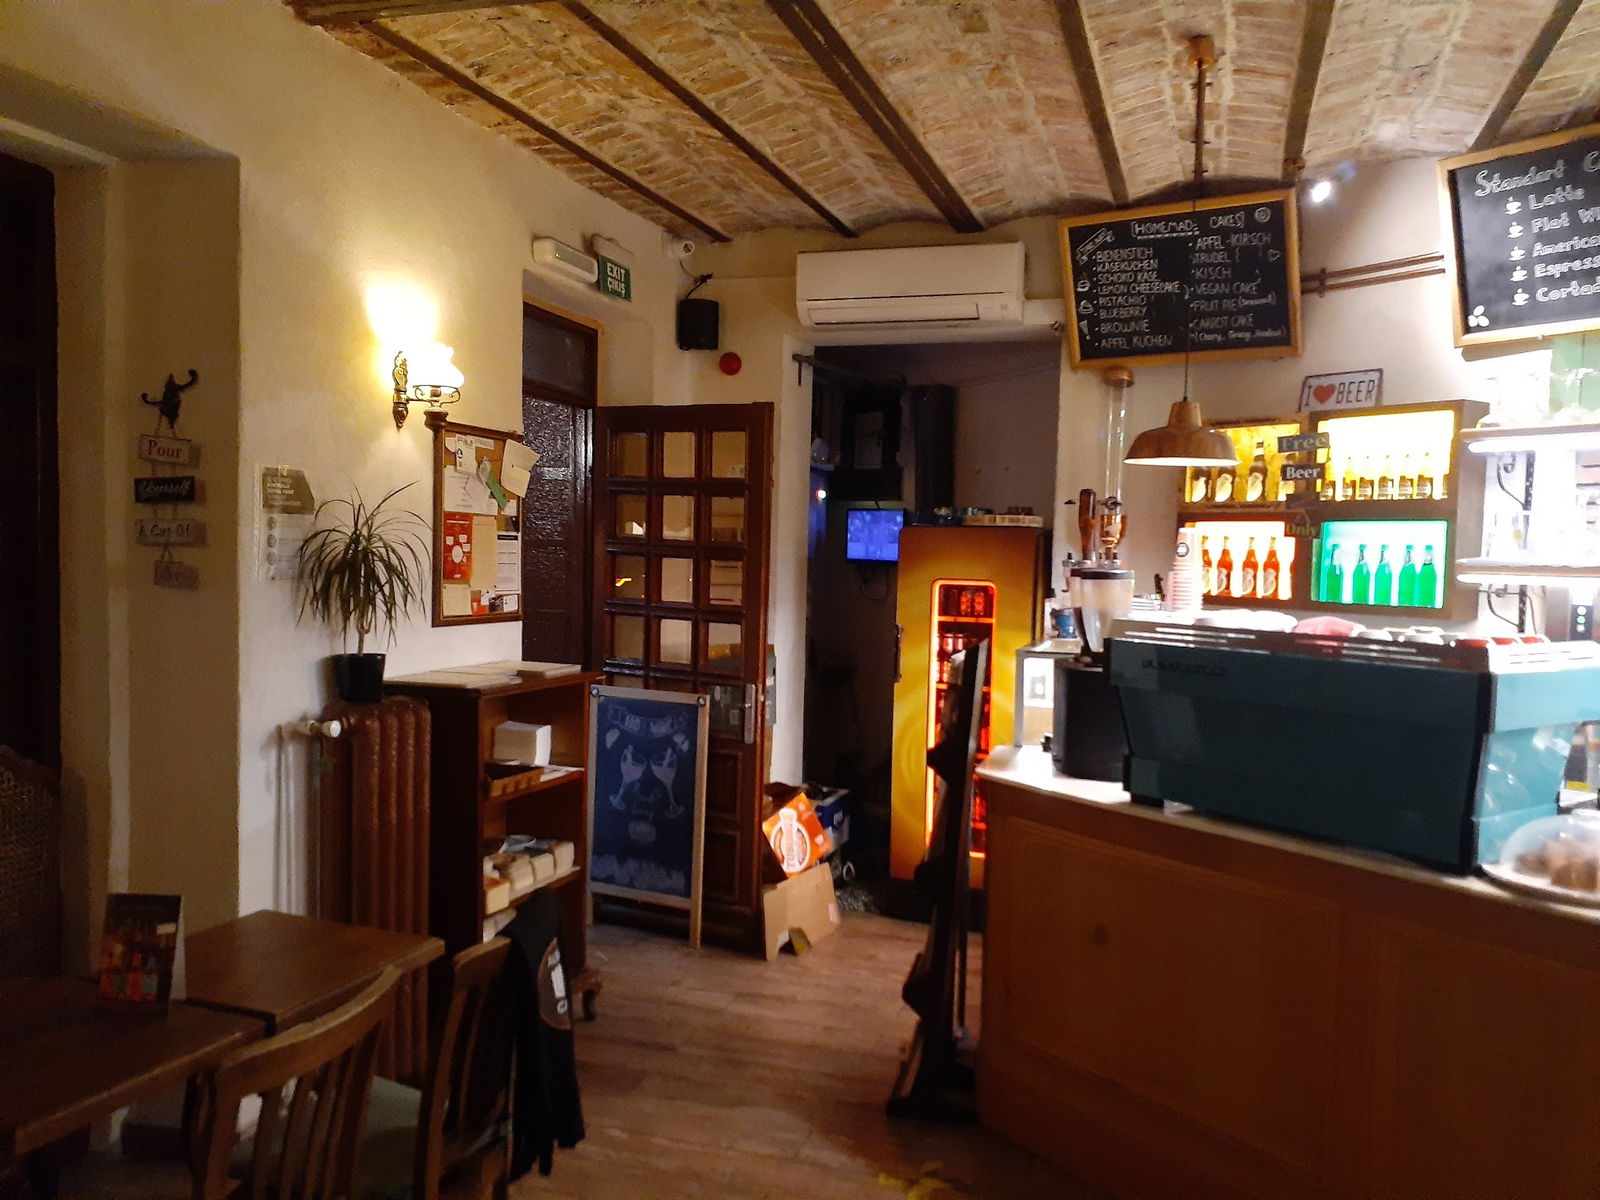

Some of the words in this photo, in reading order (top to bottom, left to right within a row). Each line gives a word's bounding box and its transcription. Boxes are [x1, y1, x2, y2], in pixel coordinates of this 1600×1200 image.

[1528, 184, 1585, 210] Latte
[1531, 212, 1570, 234] Flat
[606, 262, 625, 281] EXIT
[1304, 385, 1313, 407] I
[1336, 379, 1375, 404] BEER
[147, 439, 183, 458] Pour
[1285, 466, 1321, 480] Beer
